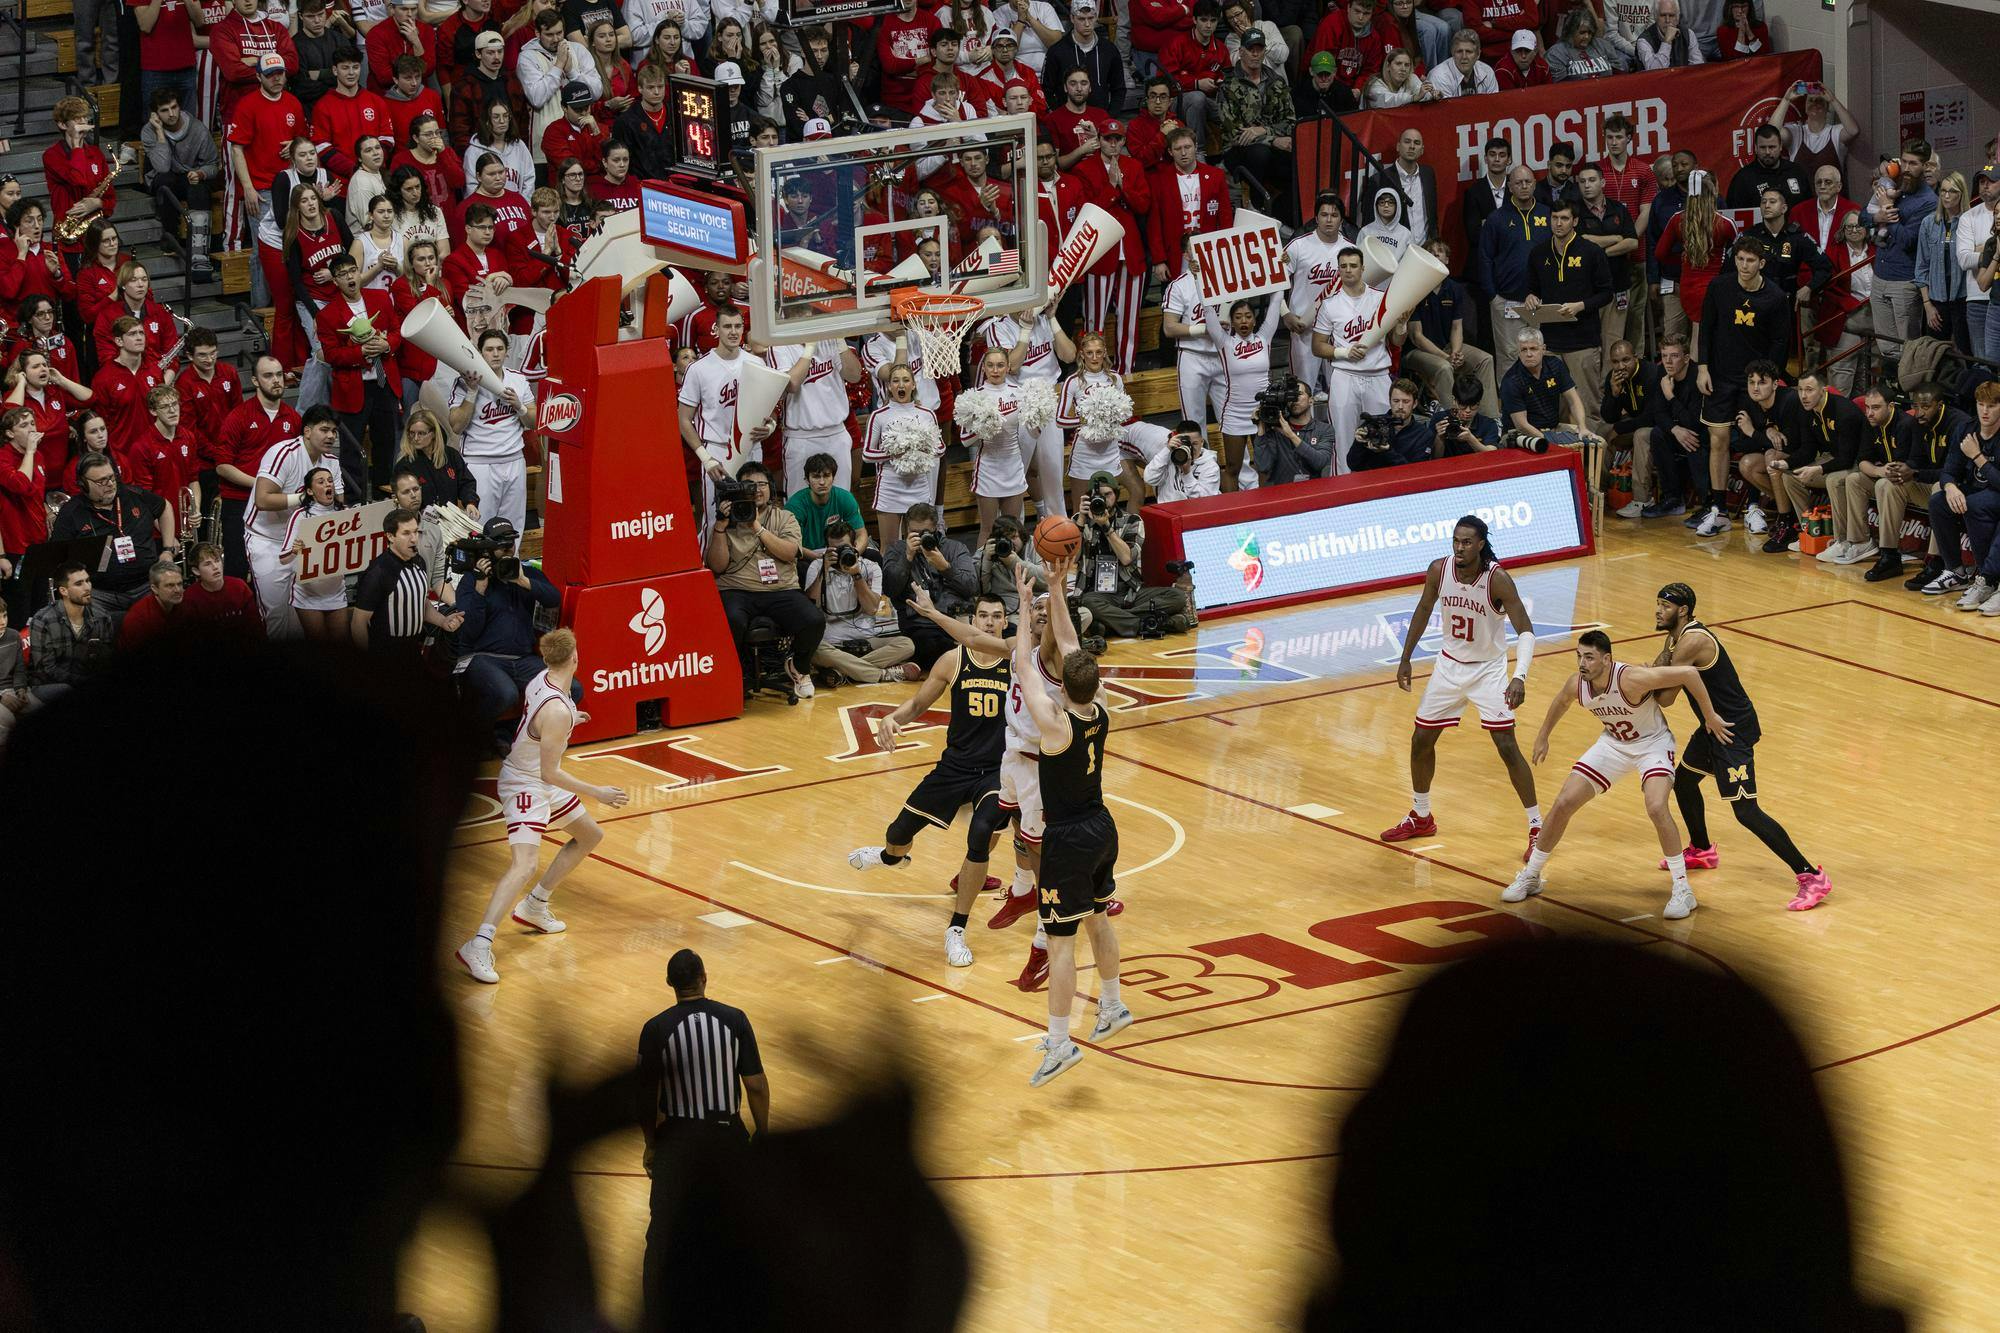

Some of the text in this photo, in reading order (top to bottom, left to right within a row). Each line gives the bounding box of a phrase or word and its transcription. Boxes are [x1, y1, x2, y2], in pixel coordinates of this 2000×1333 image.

[815, 1, 868, 14] DAKTRONICS
[648, 198, 727, 230] INTERNET VOICE
[403, 226, 436, 241] INDIANA
[667, 220, 711, 243] SECURITY
[1194, 226, 1287, 298] NOISE
[538, 402, 579, 430] LIBMAN
[315, 512, 363, 544] Get
[611, 510, 674, 539] meijer
[1441, 596, 1487, 617] INDIANA
[1451, 614, 1475, 642] 21
[961, 678, 1009, 693] MICHIGAN
[968, 691, 999, 718] 50
[1602, 720, 1640, 742] 32
[1086, 742, 1096, 776] 1
